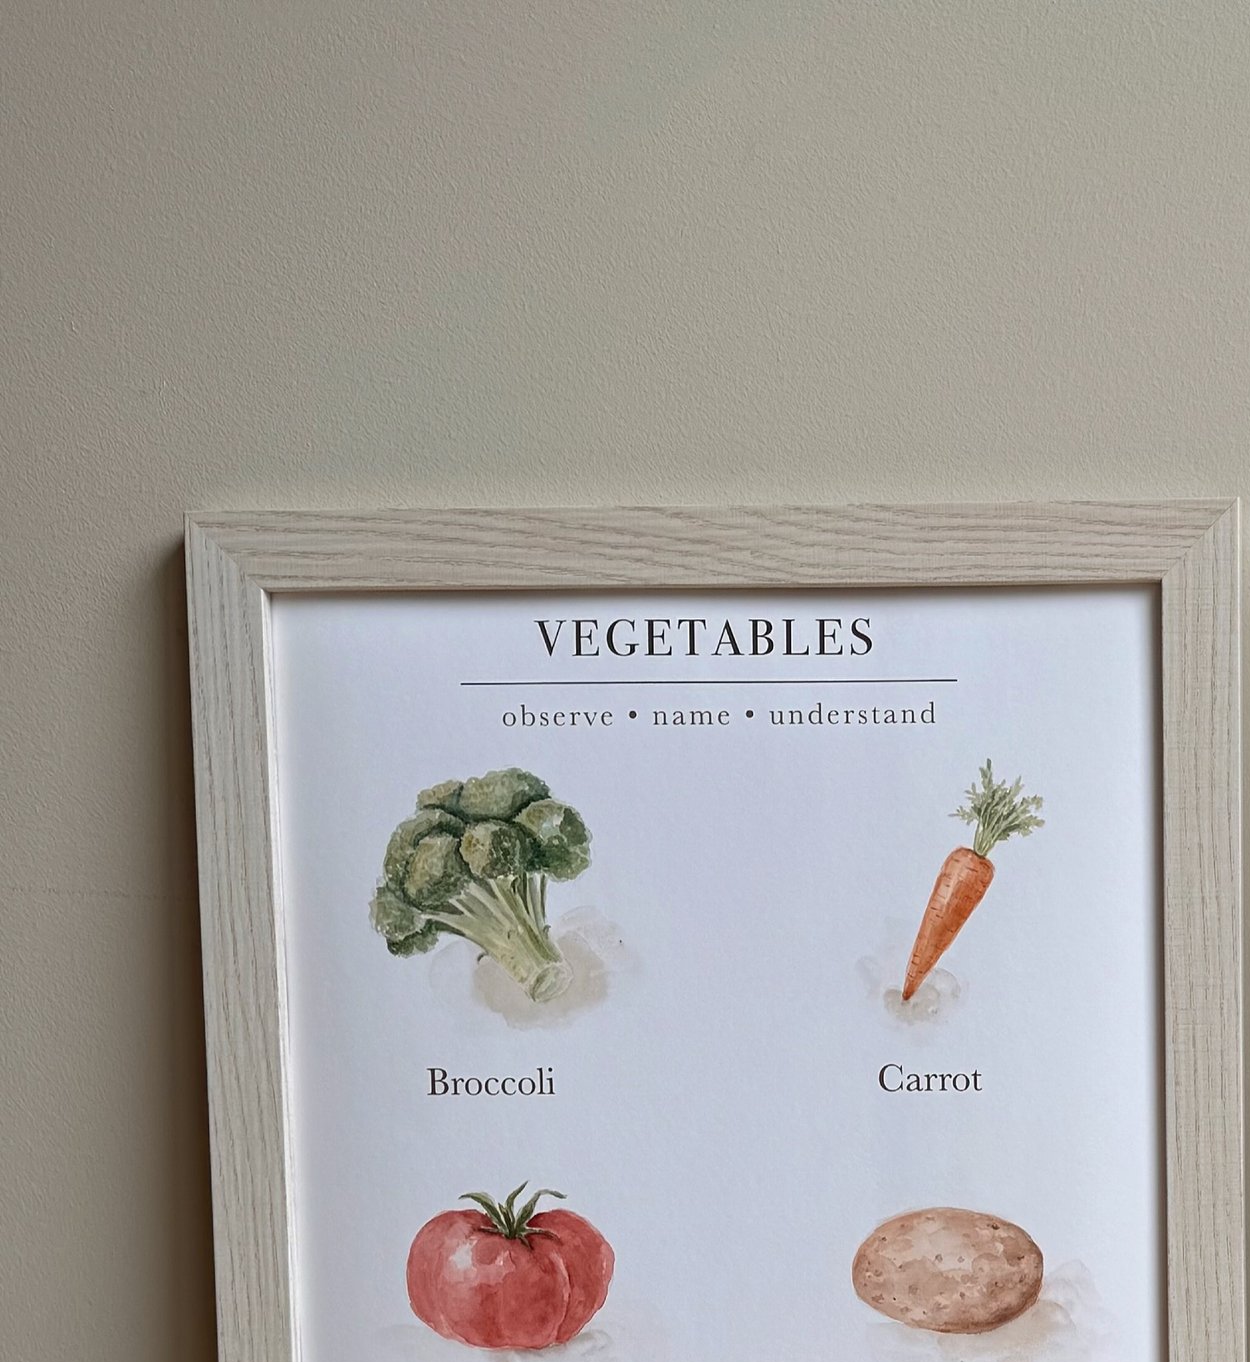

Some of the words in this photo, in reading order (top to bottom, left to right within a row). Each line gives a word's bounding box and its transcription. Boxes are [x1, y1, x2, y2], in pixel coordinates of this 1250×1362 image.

[534, 617, 874, 658] VEGETABLES
[503, 705, 614, 728] observe
[652, 709, 731, 727] name
[770, 702, 937, 727] understand
[427, 1068, 556, 1097] Broccoli
[879, 1064, 984, 1094] Carrot
